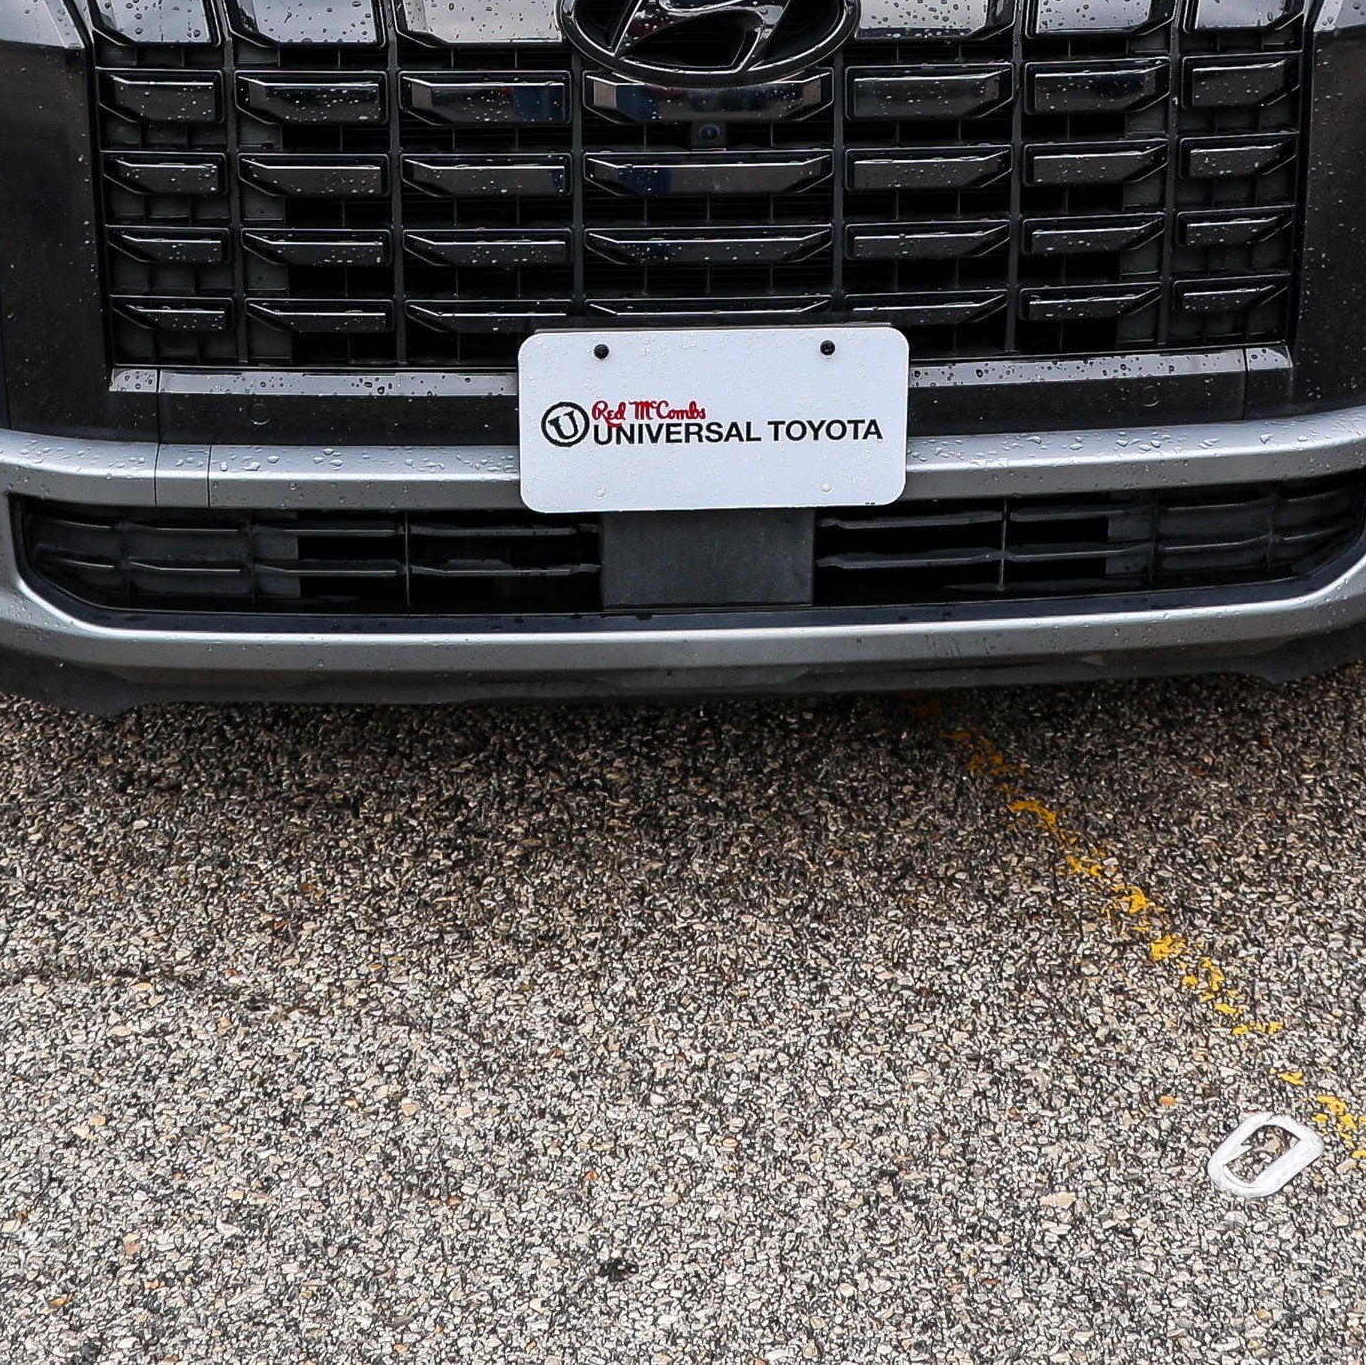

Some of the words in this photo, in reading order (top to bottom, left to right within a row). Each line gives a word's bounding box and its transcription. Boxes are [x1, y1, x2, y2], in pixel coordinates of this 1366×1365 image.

[591, 400, 627, 428] Red
[628, 400, 707, 420] McCombs
[593, 421, 762, 445] UNIVERSAL
[767, 419, 884, 442] TOYOTA
